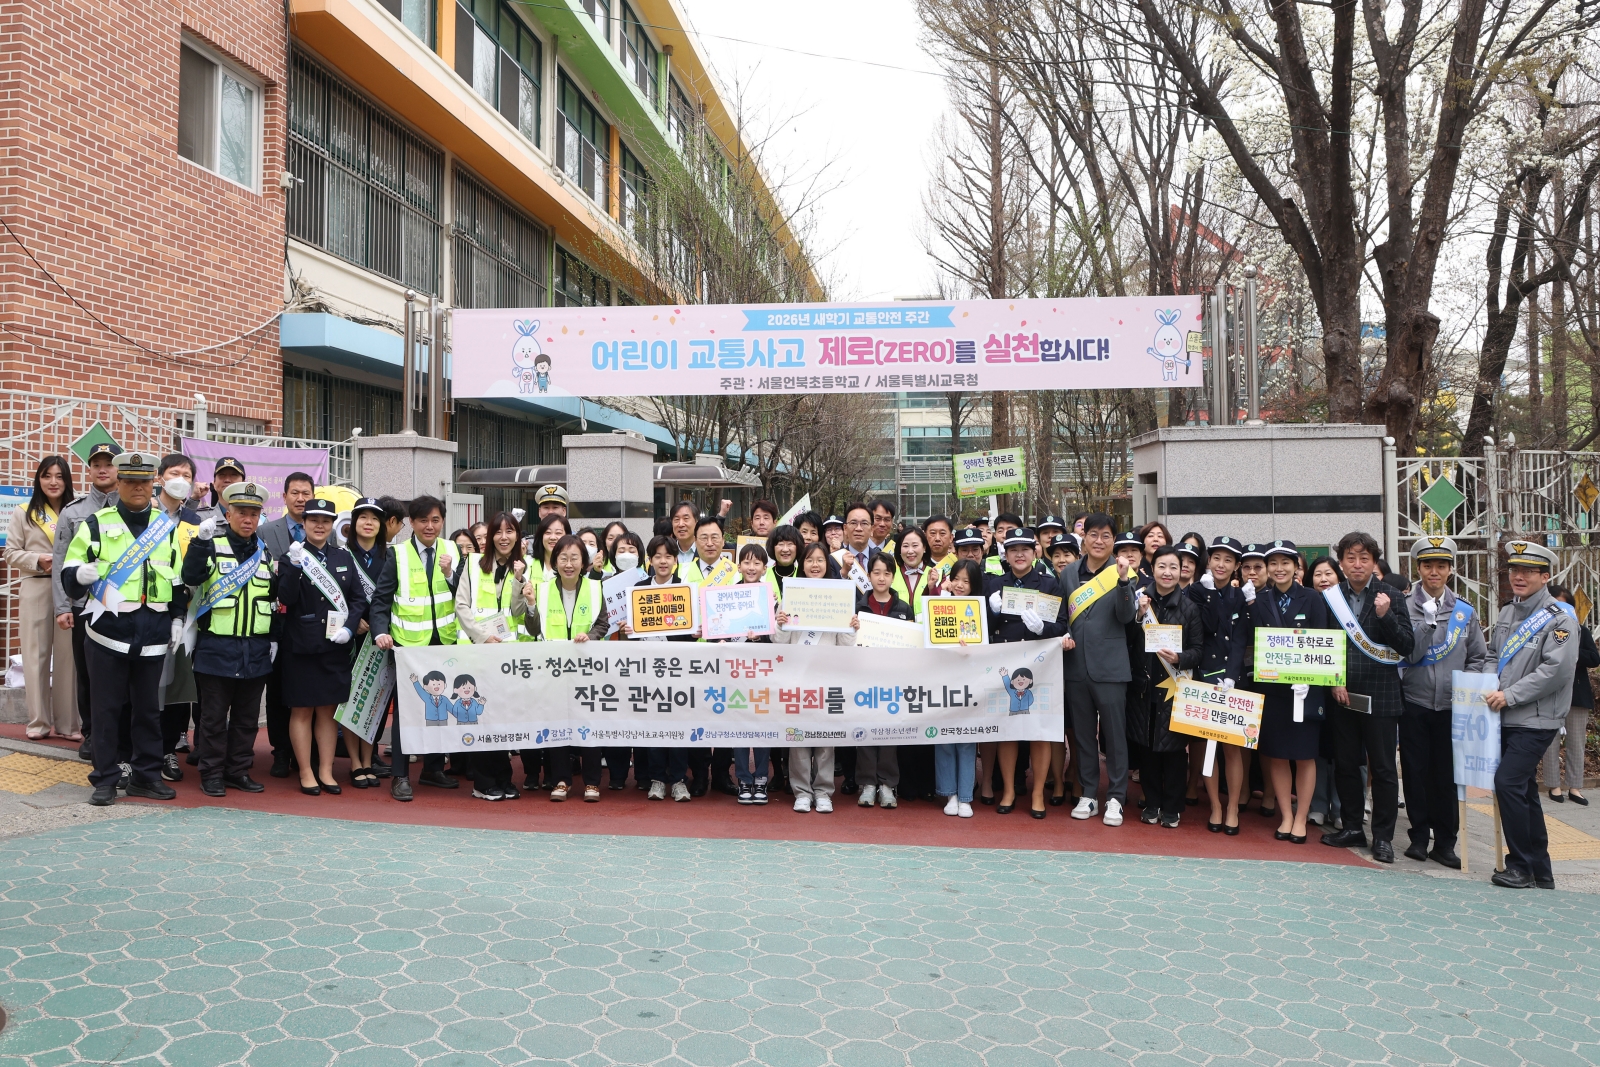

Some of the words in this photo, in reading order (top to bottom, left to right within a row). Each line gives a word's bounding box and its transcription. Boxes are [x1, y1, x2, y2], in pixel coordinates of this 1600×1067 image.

[767, 313, 810, 326] 2026년
[813, 311, 849, 326] 새학기
[853, 310, 901, 325] 교통안전
[905, 310, 930, 324] 주간
[591, 340, 678, 371] 어린이
[687, 338, 806, 369] 교통사고
[818, 336, 977, 367] 제로(ZERO)를
[983, 332, 1110, 363] 실천합시다!
[719, 377, 745, 391] 주관
[757, 374, 860, 391] 서울언북초등학교
[875, 373, 978, 388] 서울특별시교육청
[962, 458, 985, 470] 정해진
[985, 453, 1015, 467] 통학로로
[963, 470, 993, 484] 안전등교
[993, 467, 1017, 479] 하세요.
[638, 593, 661, 605] 스쿨존
[662, 593, 686, 603] 30km,
[717, 592, 733, 602] 걸어서
[734, 590, 752, 601] 학교로!
[639, 605, 655, 616] 우리
[656, 603, 685, 615] 아이들의
[715, 602, 737, 613] 건강에도
[737, 600, 755, 611] 좋아요!
[932, 604, 956, 615] 멈춰요!
[640, 616, 663, 628] 생명선
[933, 616, 957, 627] 살펴요!
[934, 628, 958, 639] 건너요!
[1266, 635, 1294, 648] 정해진
[1296, 636, 1334, 649] 통학로로
[1265, 652, 1302, 665] 안전등교
[1304, 653, 1335, 665] 하세요.
[614, 657, 647, 677] 살기
[652, 657, 683, 678] 좋은
[688, 658, 720, 677] 도시
[725, 658, 774, 679] 강남구
[574, 684, 620, 713] 작은
[628, 685, 696, 713] 관심이
[704, 686, 770, 715] 청소년
[779, 686, 846, 715] 범죄를
[854, 685, 979, 714] 예방합니다.
[1182, 686, 1200, 700] 우리
[1201, 688, 1227, 706] 손으로
[1228, 696, 1255, 713] 안전한
[1184, 705, 1209, 721] 등굣길
[1211, 710, 1247, 727] 만들어요.
[551, 728, 573, 738] 강남구
[591, 730, 685, 741] 서울특별시강남서초교육지원청
[704, 731, 779, 740] 강남구청소년상담복지센터
[804, 731, 847, 740] 강남청소년센터
[870, 727, 919, 736] 역삼청소년센터
[940, 725, 999, 736] 한국청소년육성회
[477, 732, 530, 744] 서울강남경찰서
